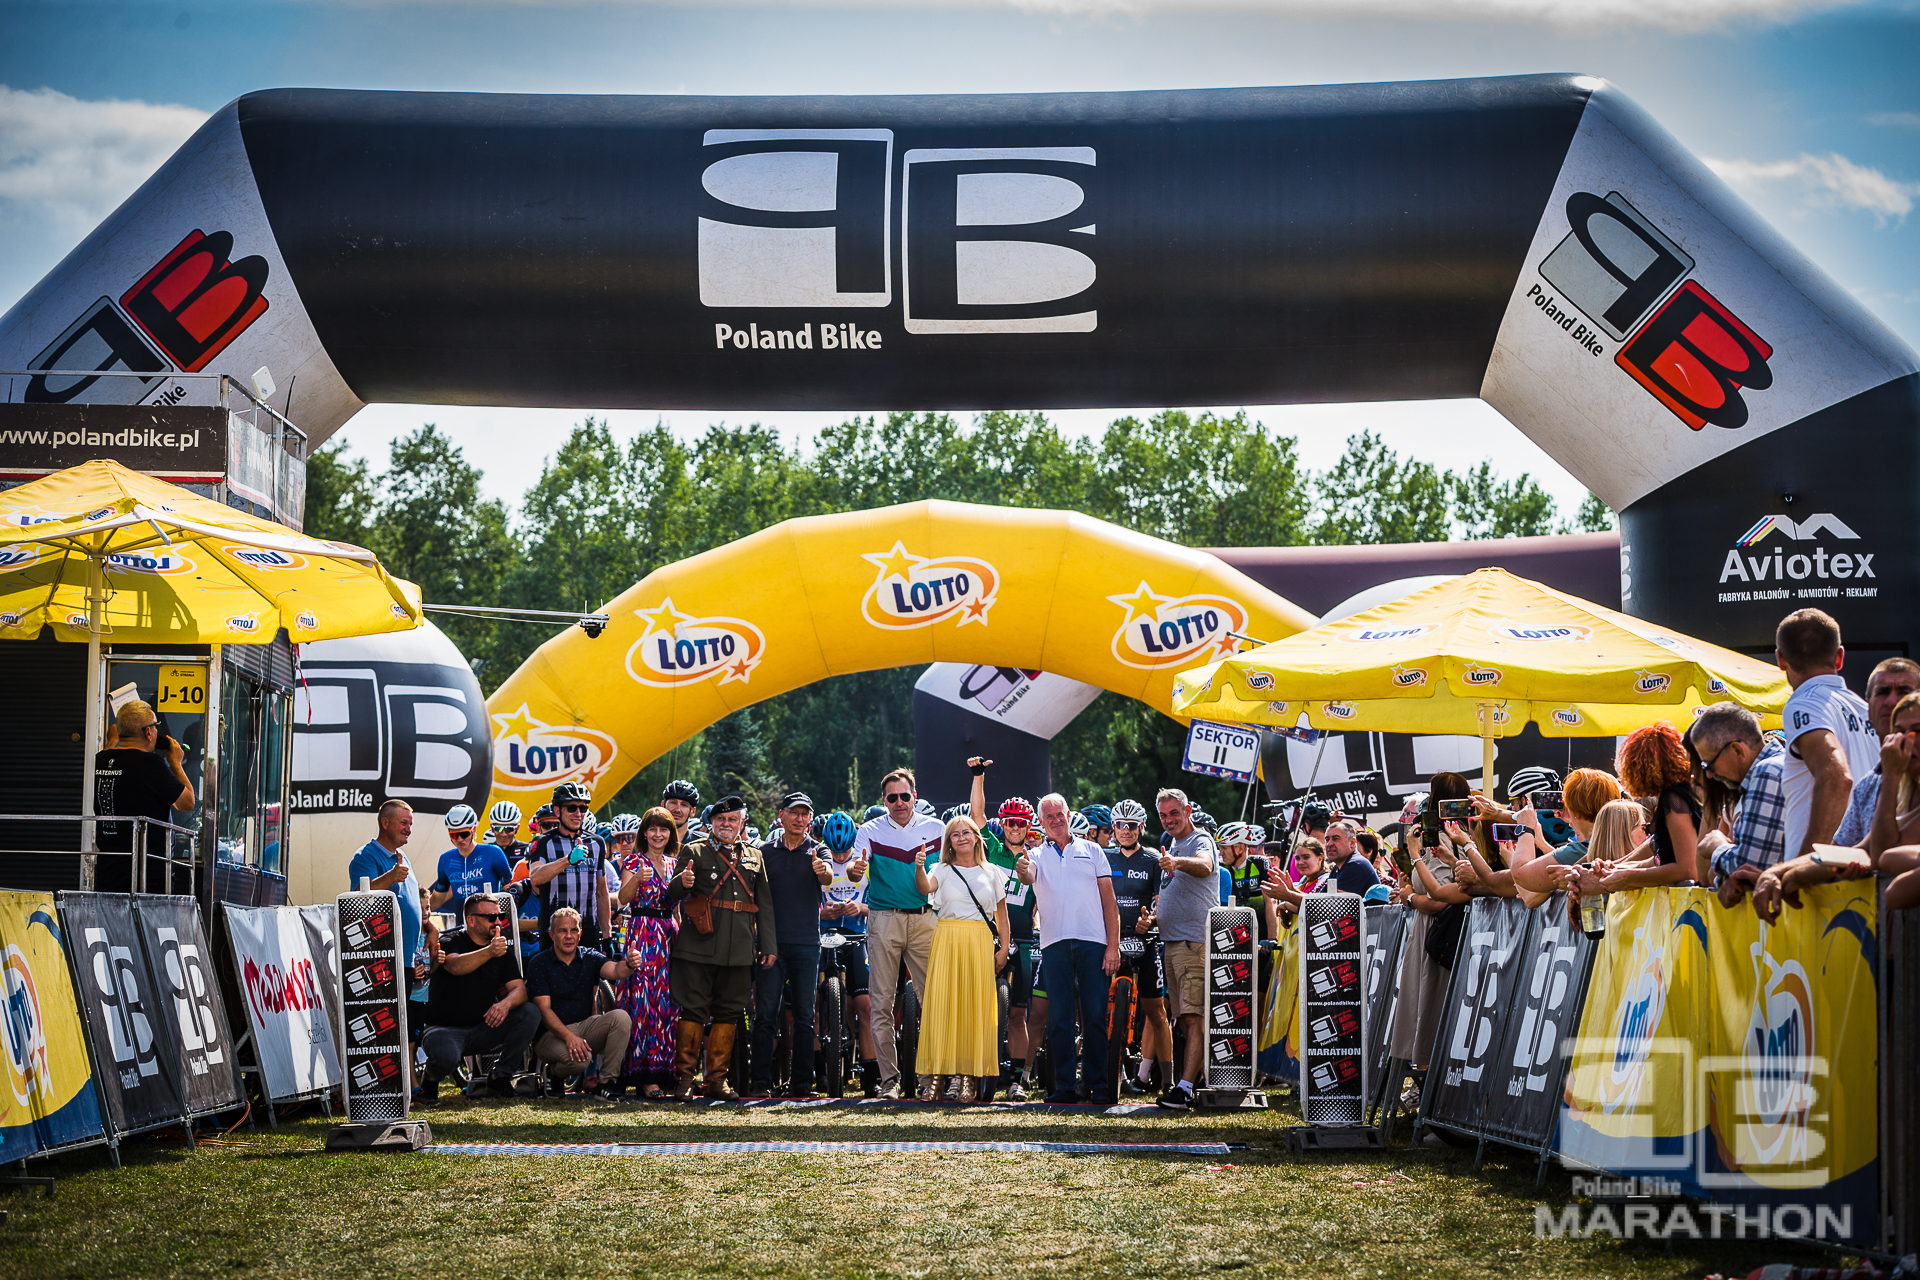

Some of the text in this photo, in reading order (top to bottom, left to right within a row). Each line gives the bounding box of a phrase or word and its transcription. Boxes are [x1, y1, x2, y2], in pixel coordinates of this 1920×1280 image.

[1526, 283, 1604, 358] Poland Bike
[715, 322, 882, 350] Poland Bike
[1718, 546, 1876, 583] Aviotex
[891, 573, 970, 613] LOTTO
[1718, 591, 1752, 603] FABRYKA
[1753, 587, 1790, 601] BALONÓW
[1797, 586, 1839, 599] NAMIOTÓW
[1846, 587, 1878, 598] REKLAMY
[1140, 610, 1219, 653] LOTTO
[1359, 628, 1422, 640] LOTTO
[1507, 627, 1571, 640] LOTTO
[657, 634, 736, 670] LOTTO
[1250, 676, 1269, 687] LOTTO
[1399, 671, 1421, 684] LOTTO
[1471, 672, 1495, 682] LOTTO
[1642, 677, 1665, 689] LOTTO
[159, 685, 205, 705] J-10
[996, 685, 1031, 717] Poland Bike
[1195, 727, 1255, 751] SEKTOR
[508, 742, 588, 775] LOTTO
[1212, 745, 1228, 765] II
[290, 789, 373, 808] oland Bike
[341, 950, 395, 960] MARATHON
[1121, 942, 1144, 951] 1079
[1306, 952, 1361, 961] MARATHON
[347, 1045, 400, 1056] MARATHON
[1307, 1048, 1362, 1056] MARATHON
